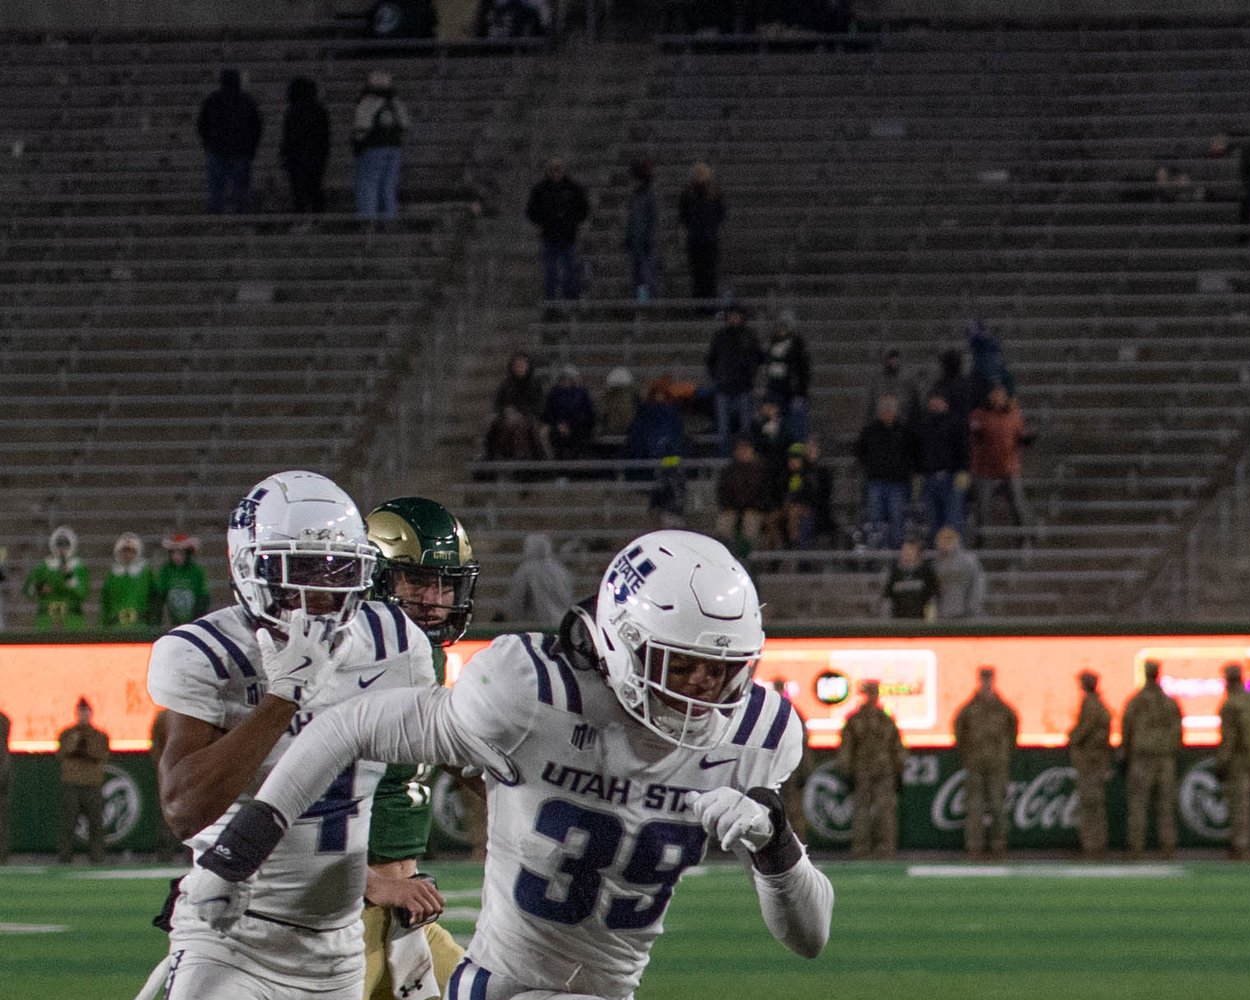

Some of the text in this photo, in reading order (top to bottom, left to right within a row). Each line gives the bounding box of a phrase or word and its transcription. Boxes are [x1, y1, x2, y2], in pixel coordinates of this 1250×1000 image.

[432, 550, 453, 560] GRIT
[614, 555, 645, 595] STATE
[541, 760, 631, 805] UTAH
[513, 797, 709, 931] 39
